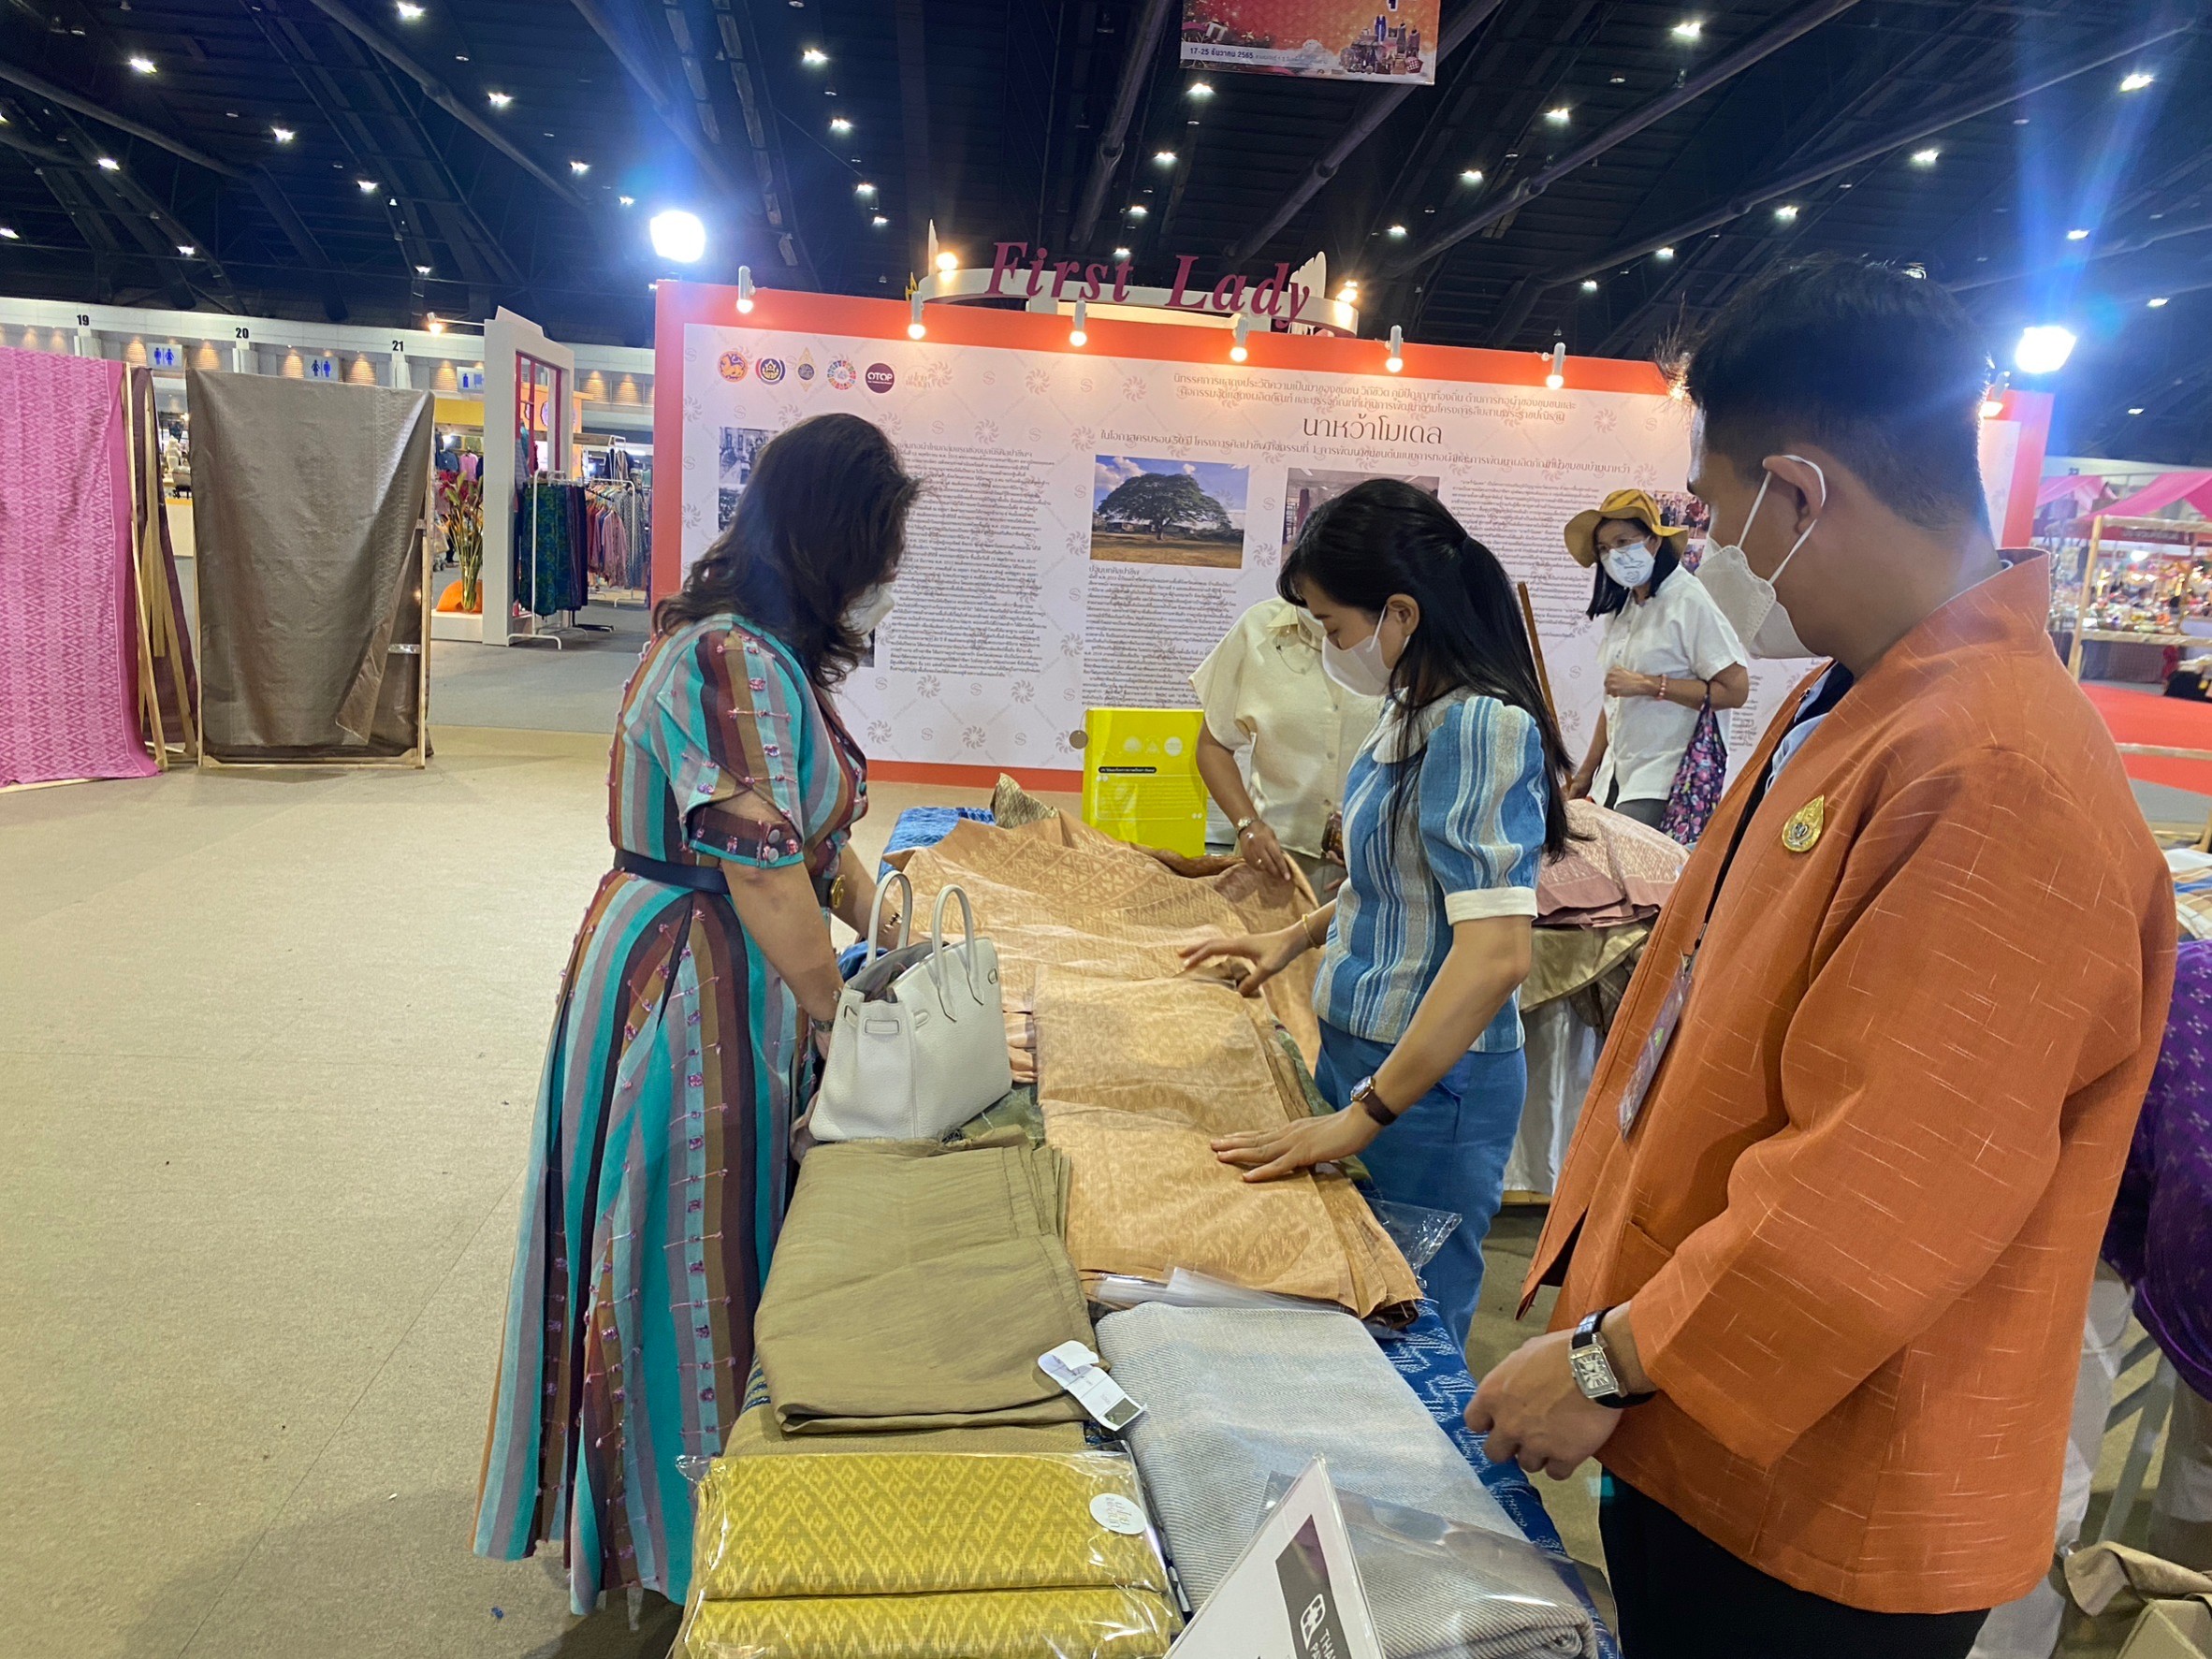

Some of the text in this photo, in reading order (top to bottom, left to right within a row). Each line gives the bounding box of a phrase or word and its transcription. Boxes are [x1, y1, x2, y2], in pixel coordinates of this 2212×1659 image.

[1190, 47, 1210, 56] 17-25
[984, 241, 1310, 329] First Lady
[76, 314, 91, 327] 19
[235, 327, 250, 341] 20
[392, 340, 404, 353] 21
[866, 372, 893, 381] OTOP
[1303, 414, 1443, 444] นาหว้าโมเดล
